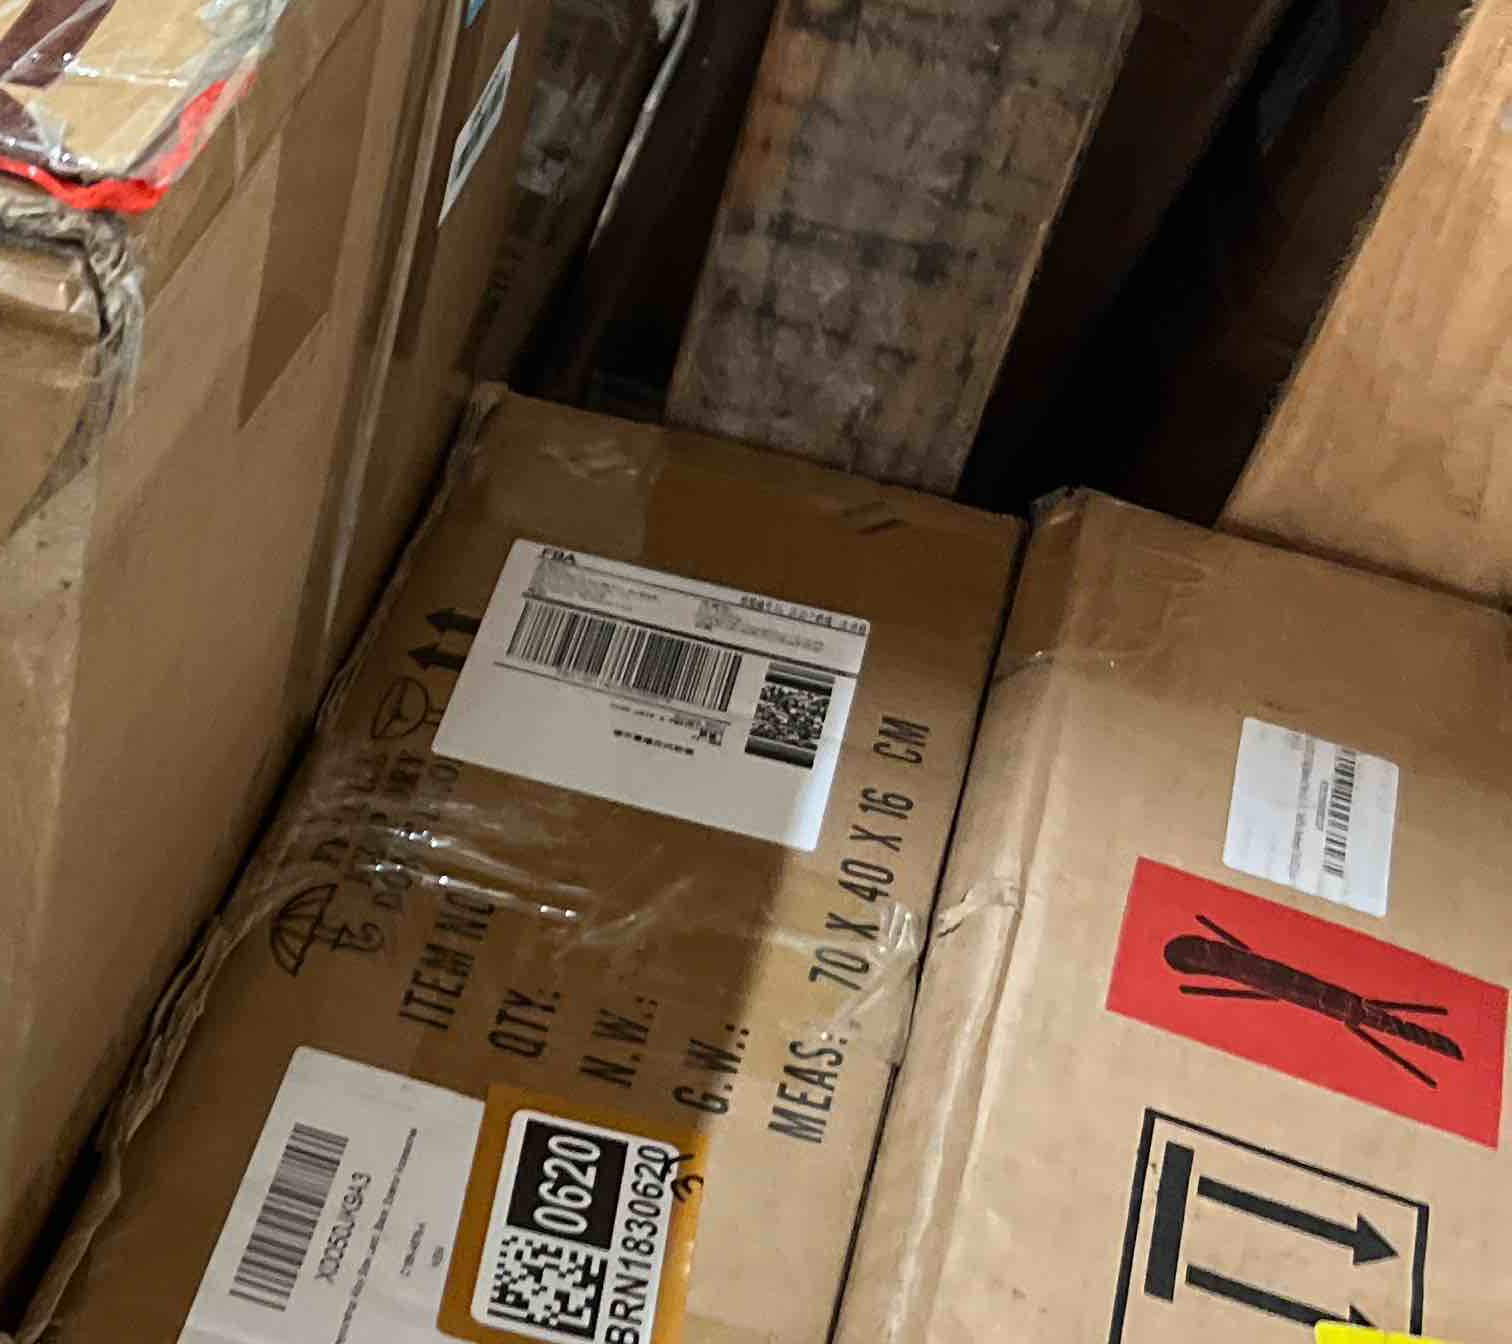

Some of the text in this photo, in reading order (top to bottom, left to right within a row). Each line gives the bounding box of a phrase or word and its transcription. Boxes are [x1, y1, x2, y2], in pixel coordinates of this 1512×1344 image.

[872, 715, 931, 766] CM
[857, 786, 916, 821] 16
[851, 824, 904, 853] X
[842, 857, 896, 906] 40
[827, 912, 881, 941] X
[398, 929, 475, 1032] ITEM
[807, 944, 870, 992] 70
[531, 1133, 604, 1236] 0620
